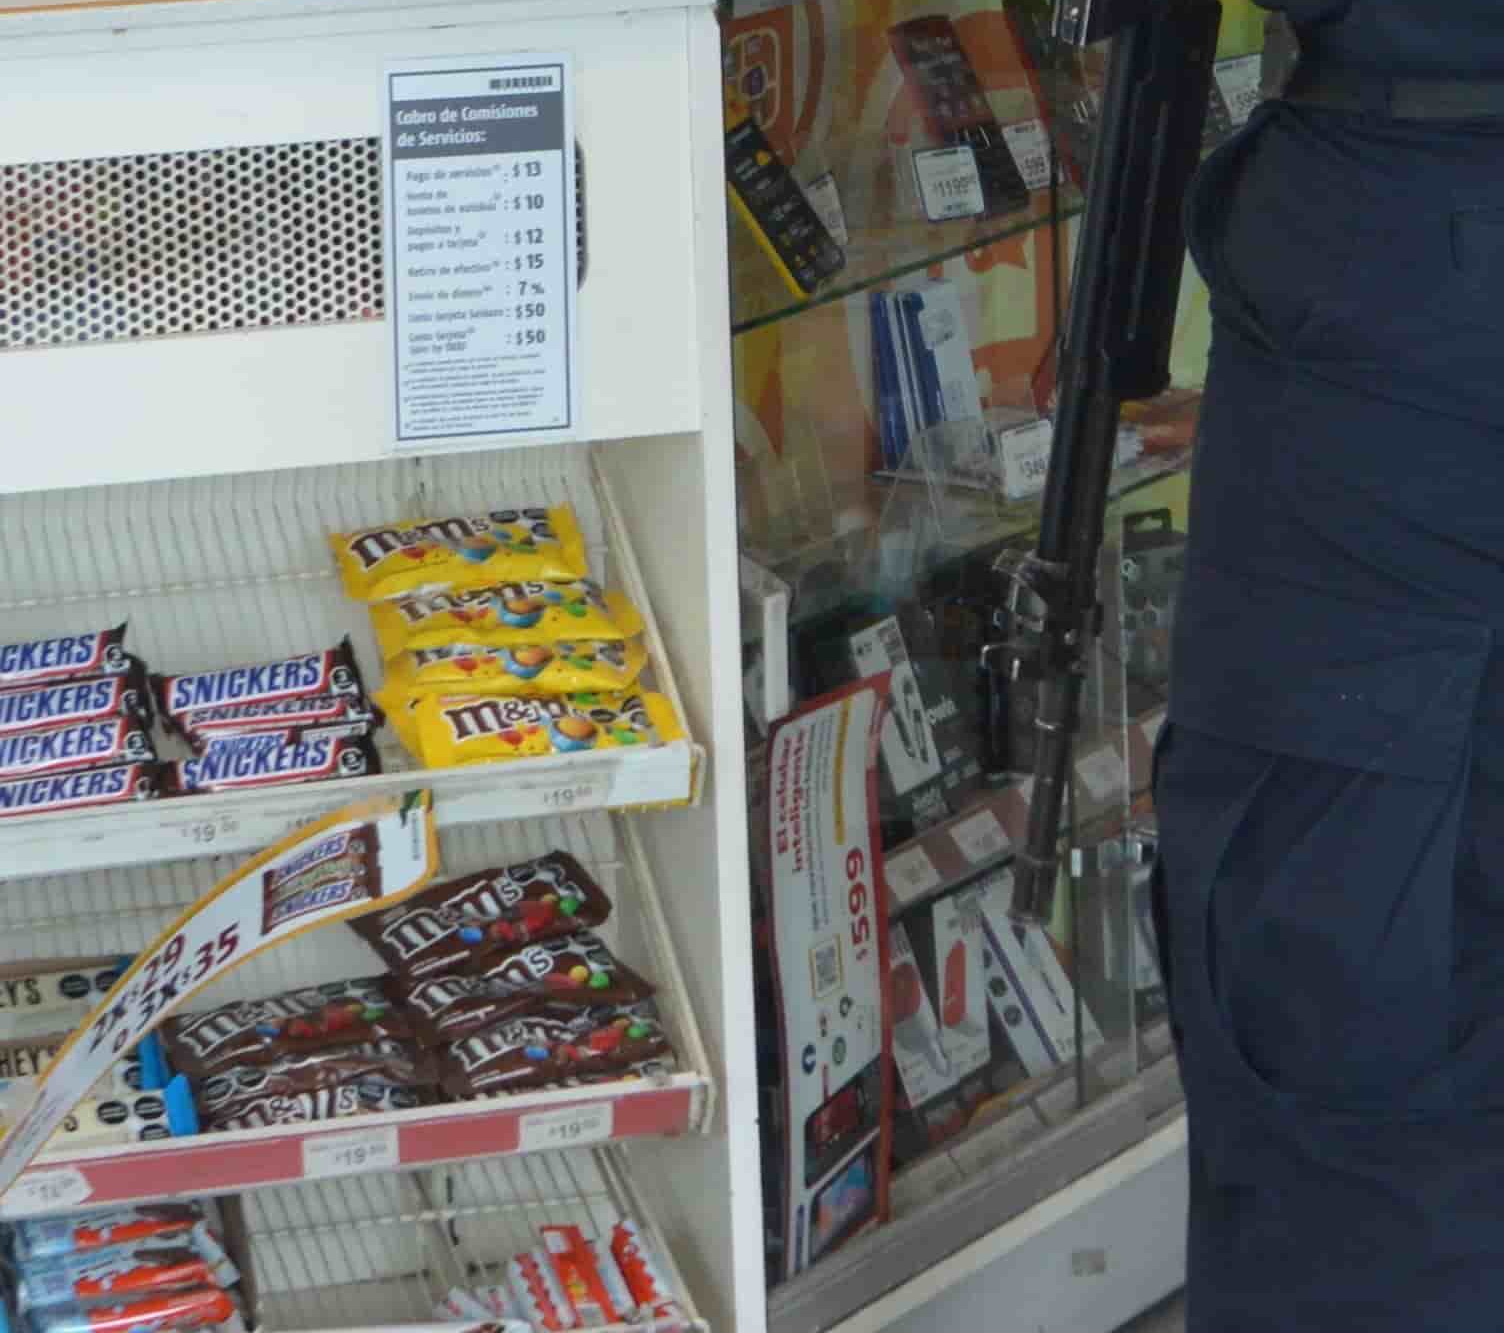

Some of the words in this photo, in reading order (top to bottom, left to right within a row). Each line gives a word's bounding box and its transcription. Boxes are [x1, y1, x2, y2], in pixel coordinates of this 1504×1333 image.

[396, 107, 437, 126] Cobro
[439, 106, 458, 123] de
[461, 103, 539, 122] Comisiones
[396, 132, 414, 148] de
[418, 127, 487, 147] Servicios:
[526, 194, 544, 210] 10
[526, 228, 544, 244] 12
[526, 254, 544, 270] 15
[174, 656, 324, 707] SNICKERS
